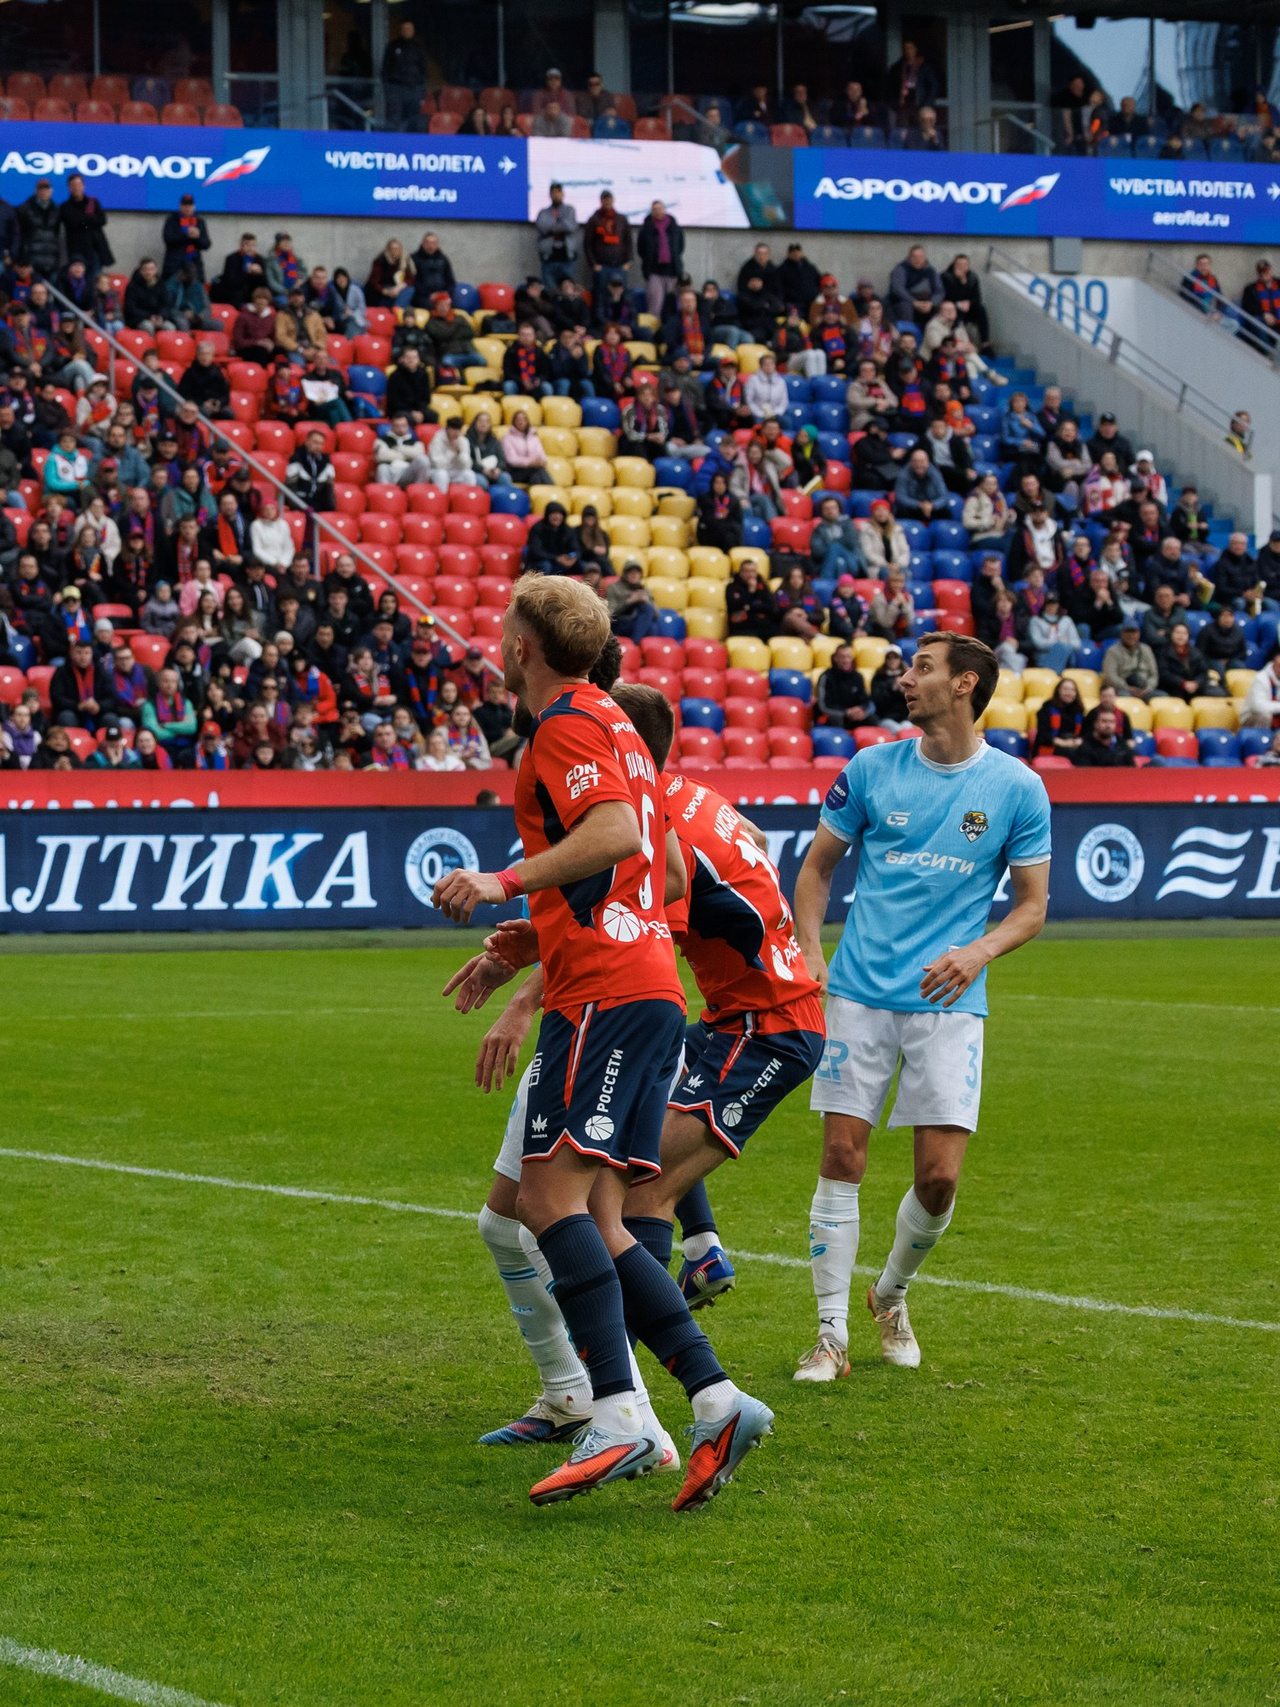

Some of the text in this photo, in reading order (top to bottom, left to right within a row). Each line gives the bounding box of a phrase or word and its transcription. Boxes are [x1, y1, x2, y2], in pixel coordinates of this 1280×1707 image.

[0, 151, 213, 180] АЭРОФЛОТ
[325, 151, 486, 174] ЧУВСТВА ПОЛЕТА
[373, 185, 457, 203] aeroflot.ru
[813, 177, 1008, 205] АЭРОФЛОТ
[1109, 178, 1256, 199] ЧУВСТВА ПОЛЕТА
[1152, 210, 1230, 228] aeroflot.ru
[565, 760, 598, 788] FON
[570, 773, 602, 800] BET
[885, 850, 975, 875] БЕТСИТИ
[596, 1048, 624, 1114] РОССЕТИ
[739, 1057, 783, 1107] РОССЕТИ
